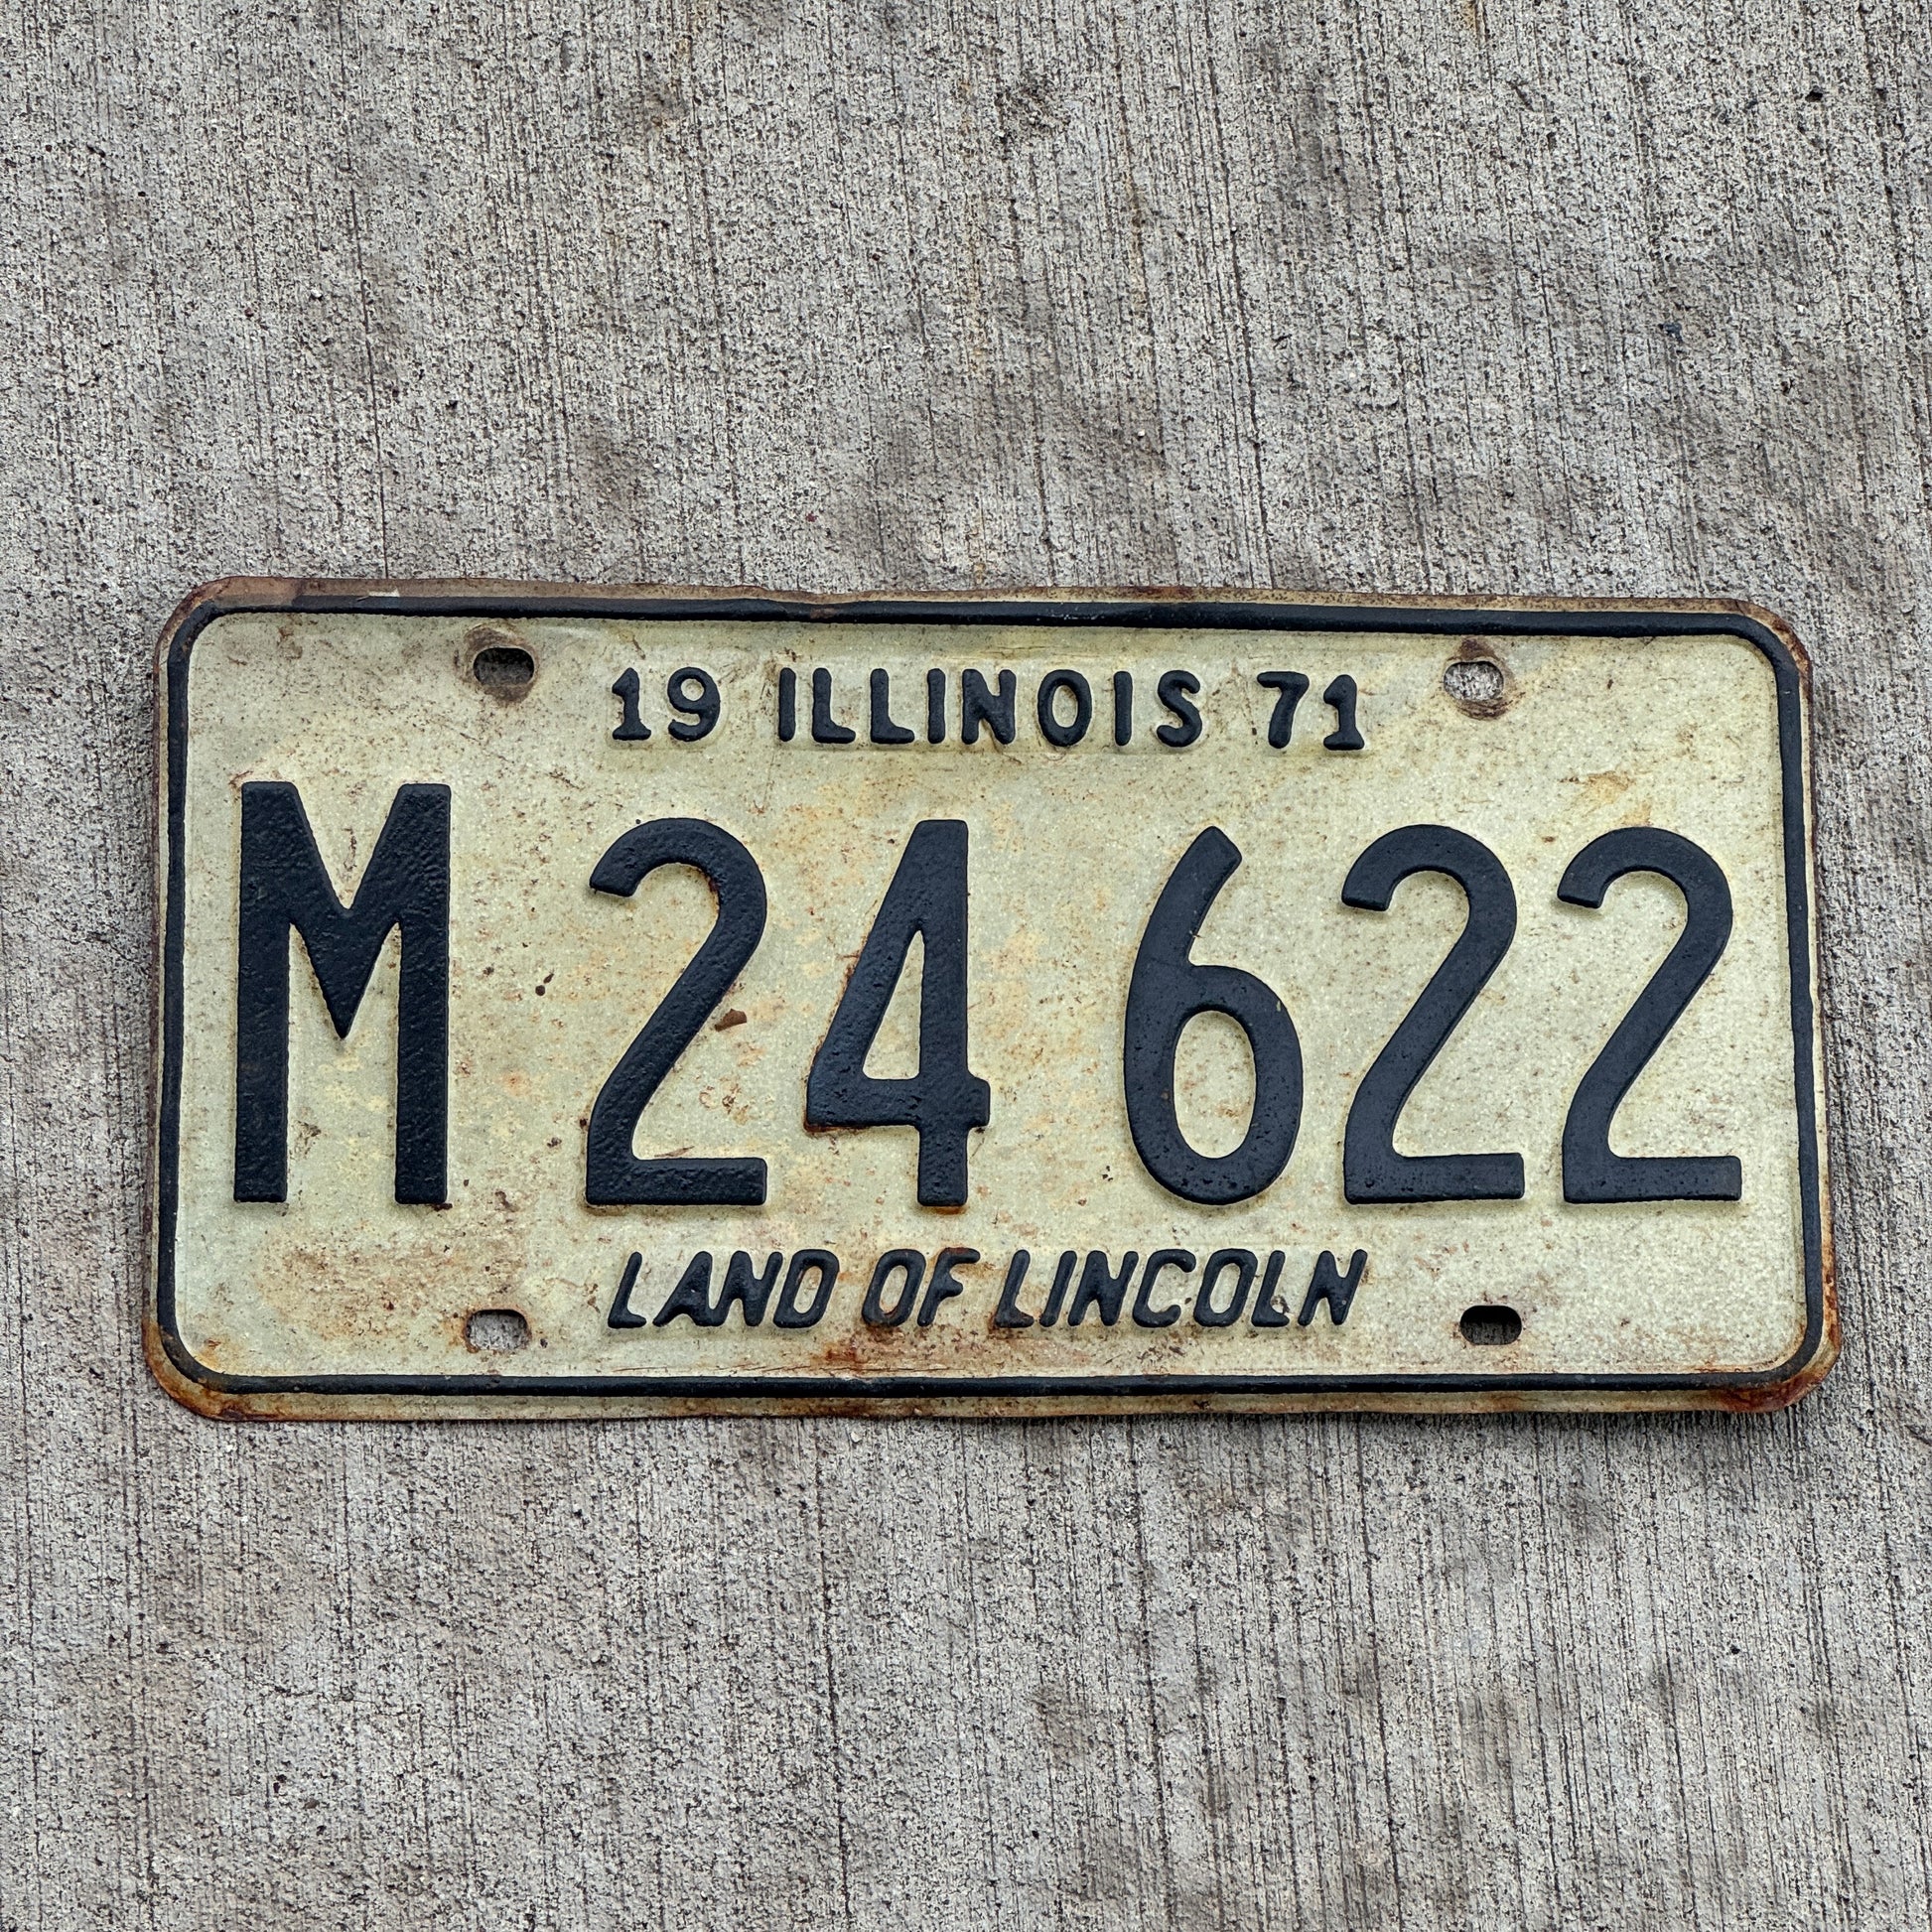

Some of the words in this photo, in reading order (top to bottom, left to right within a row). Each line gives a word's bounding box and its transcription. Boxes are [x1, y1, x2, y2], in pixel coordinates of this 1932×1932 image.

[612, 667, 721, 743] 19
[777, 667, 1203, 749] ILLINOIS
[1257, 671, 1366, 752] 71
[234, 780, 452, 1204] M
[585, 817, 991, 1208] 24
[1123, 824, 1742, 1206] 622
[608, 1249, 840, 1329] LAND
[861, 1247, 981, 1327] OF
[993, 1249, 1367, 1329] LINCOLN
